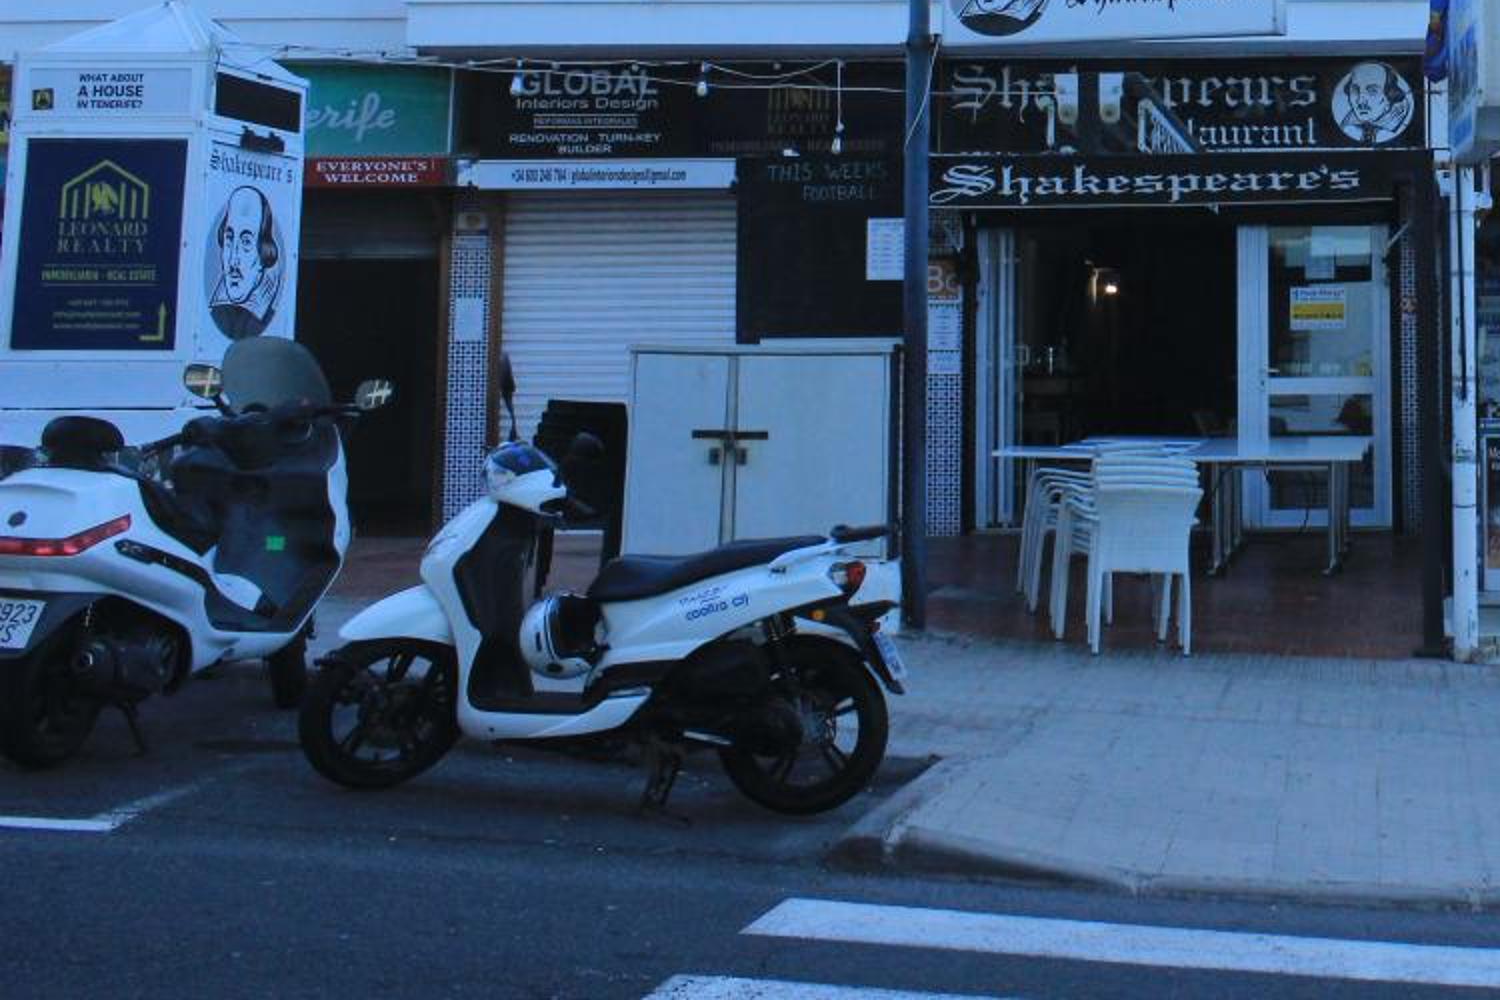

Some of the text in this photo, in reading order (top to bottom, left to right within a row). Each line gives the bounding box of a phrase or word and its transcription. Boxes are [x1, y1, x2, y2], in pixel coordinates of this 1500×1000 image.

[79, 73, 145, 83] WHAT ABOUT
[520, 69, 659, 96] GLOBAL
[78, 85, 144, 98] A HOUSE
[515, 97, 659, 112] Interiors Design
[306, 91, 397, 142] erife
[509, 132, 589, 143] RENOVATION
[557, 144, 612, 154] BUILDER
[315, 159, 428, 172] EVERYONE'S
[767, 162, 813, 182] THIS
[325, 172, 419, 184] WELCOME
[928, 163, 1361, 204] Shakespeare's
[58, 221, 148, 237] LEONARD
[57, 239, 145, 254] REALTY
[0, 602, 38, 625] 923
